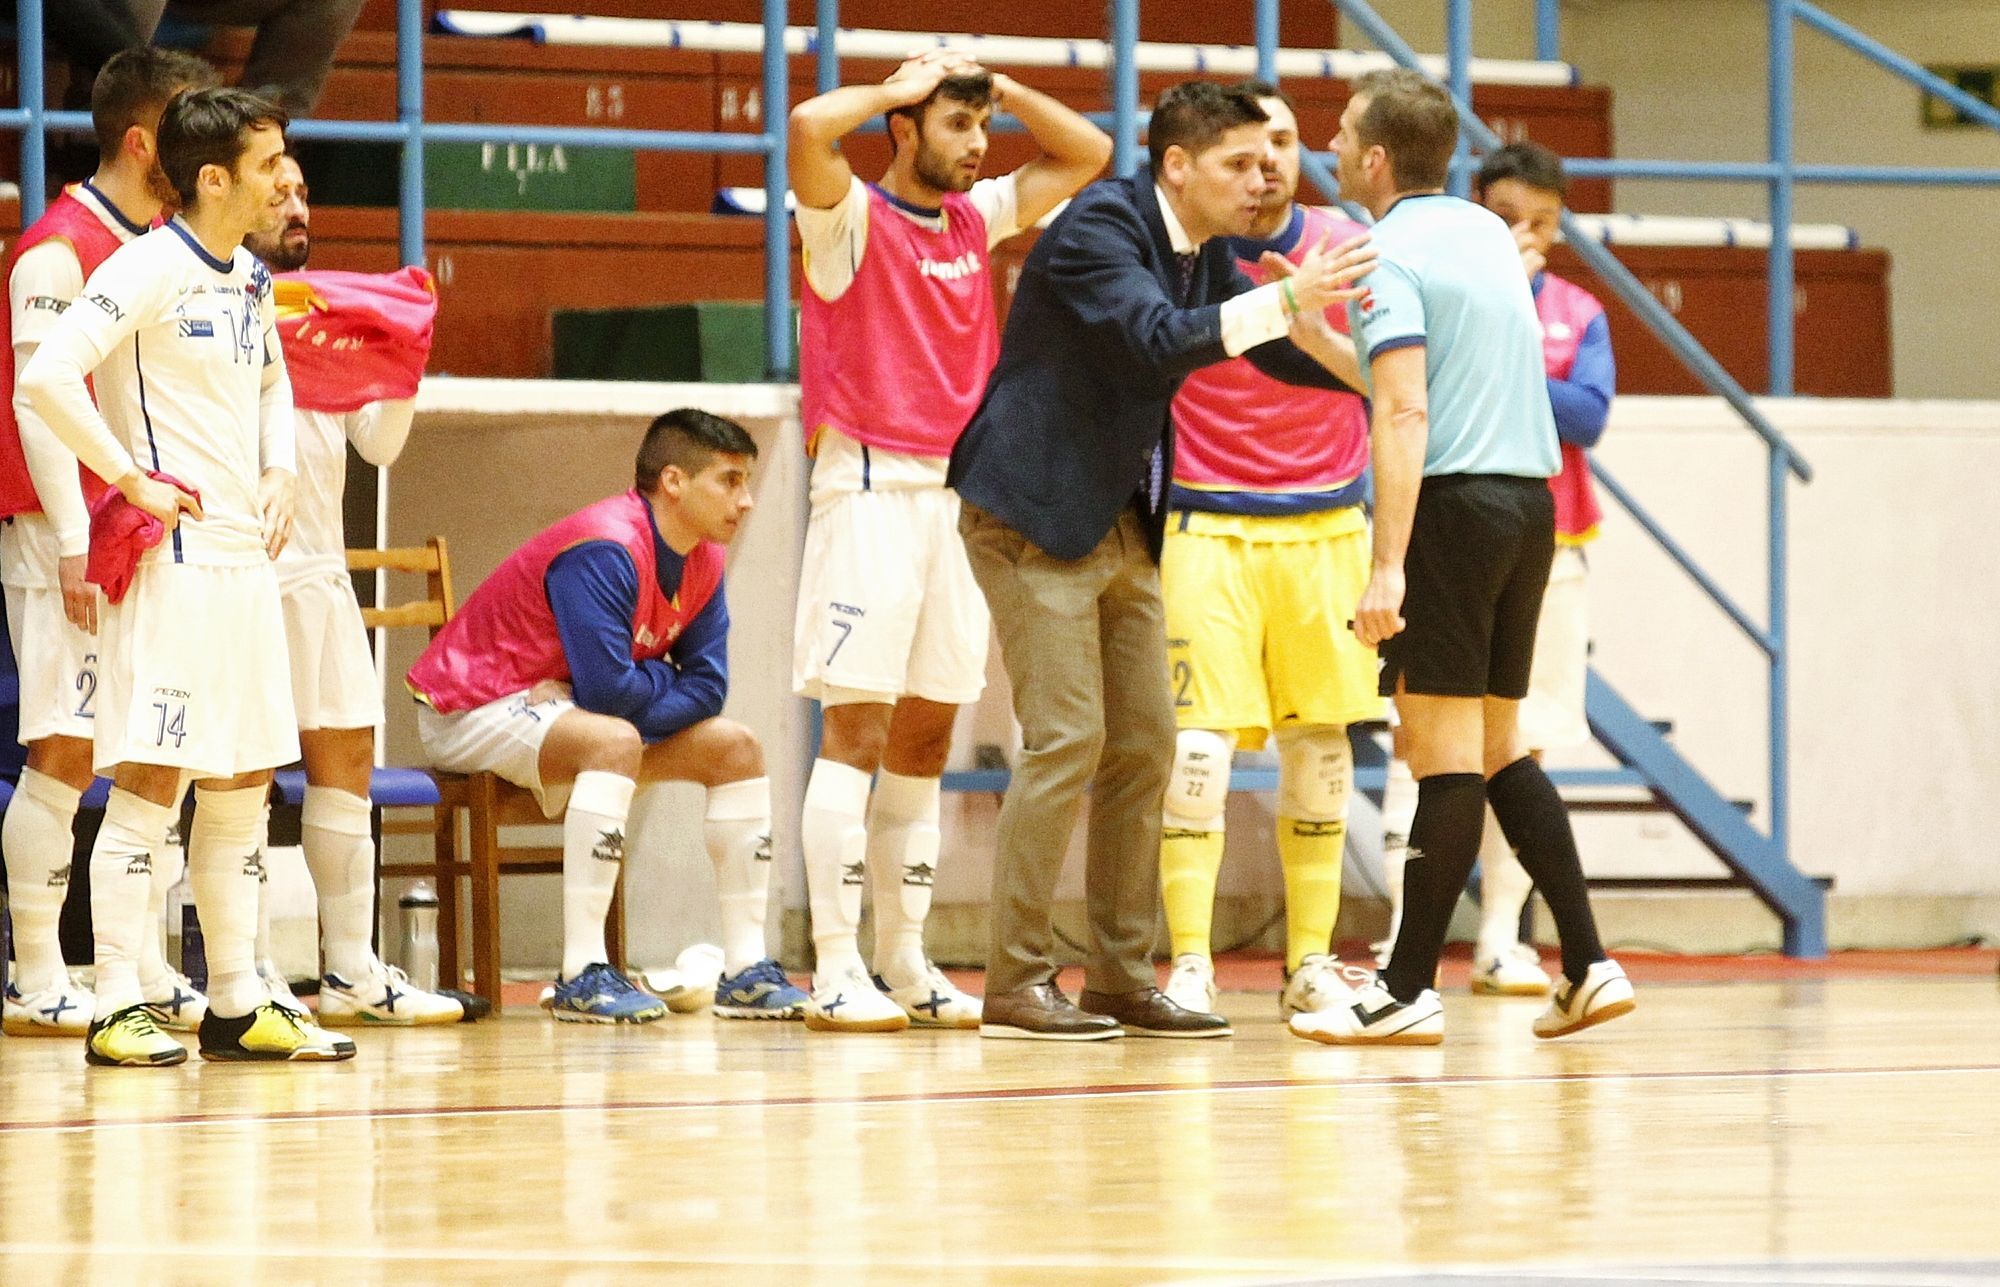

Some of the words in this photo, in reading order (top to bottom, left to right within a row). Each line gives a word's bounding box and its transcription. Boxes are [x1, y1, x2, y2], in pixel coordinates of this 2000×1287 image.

[90, 294, 126, 321] ZEN
[826, 619, 852, 667] 7
[153, 702, 187, 748] 14
